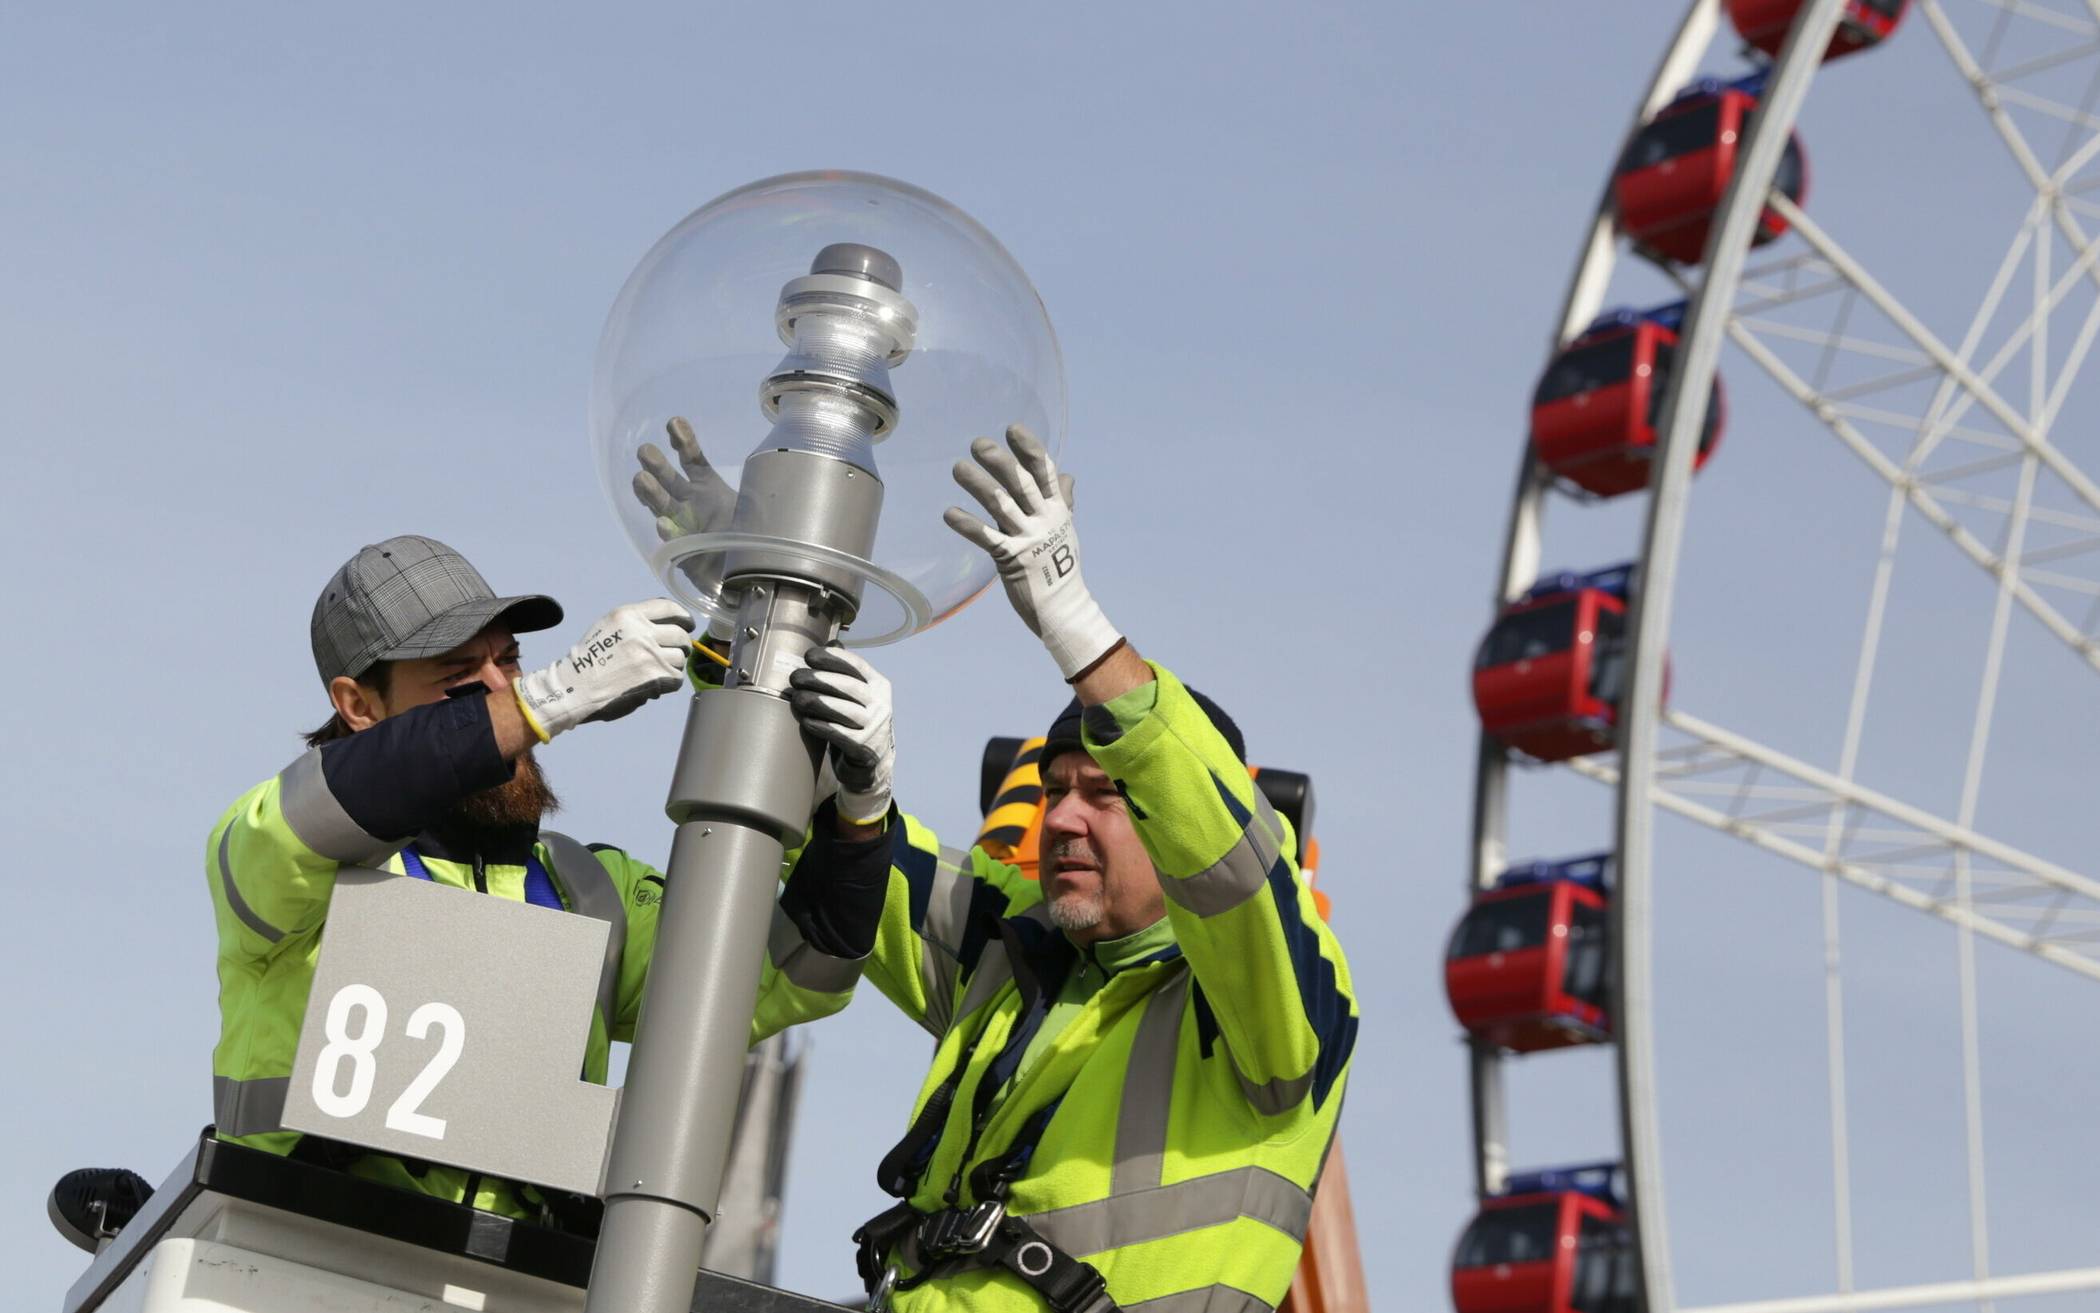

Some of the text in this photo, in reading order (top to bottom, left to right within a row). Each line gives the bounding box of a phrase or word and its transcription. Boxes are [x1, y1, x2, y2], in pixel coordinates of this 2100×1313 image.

[1031, 533, 1061, 558] MAPA
[1051, 543, 1075, 578] B
[572, 630, 622, 674] HyFlex
[312, 983, 466, 1140] 82
